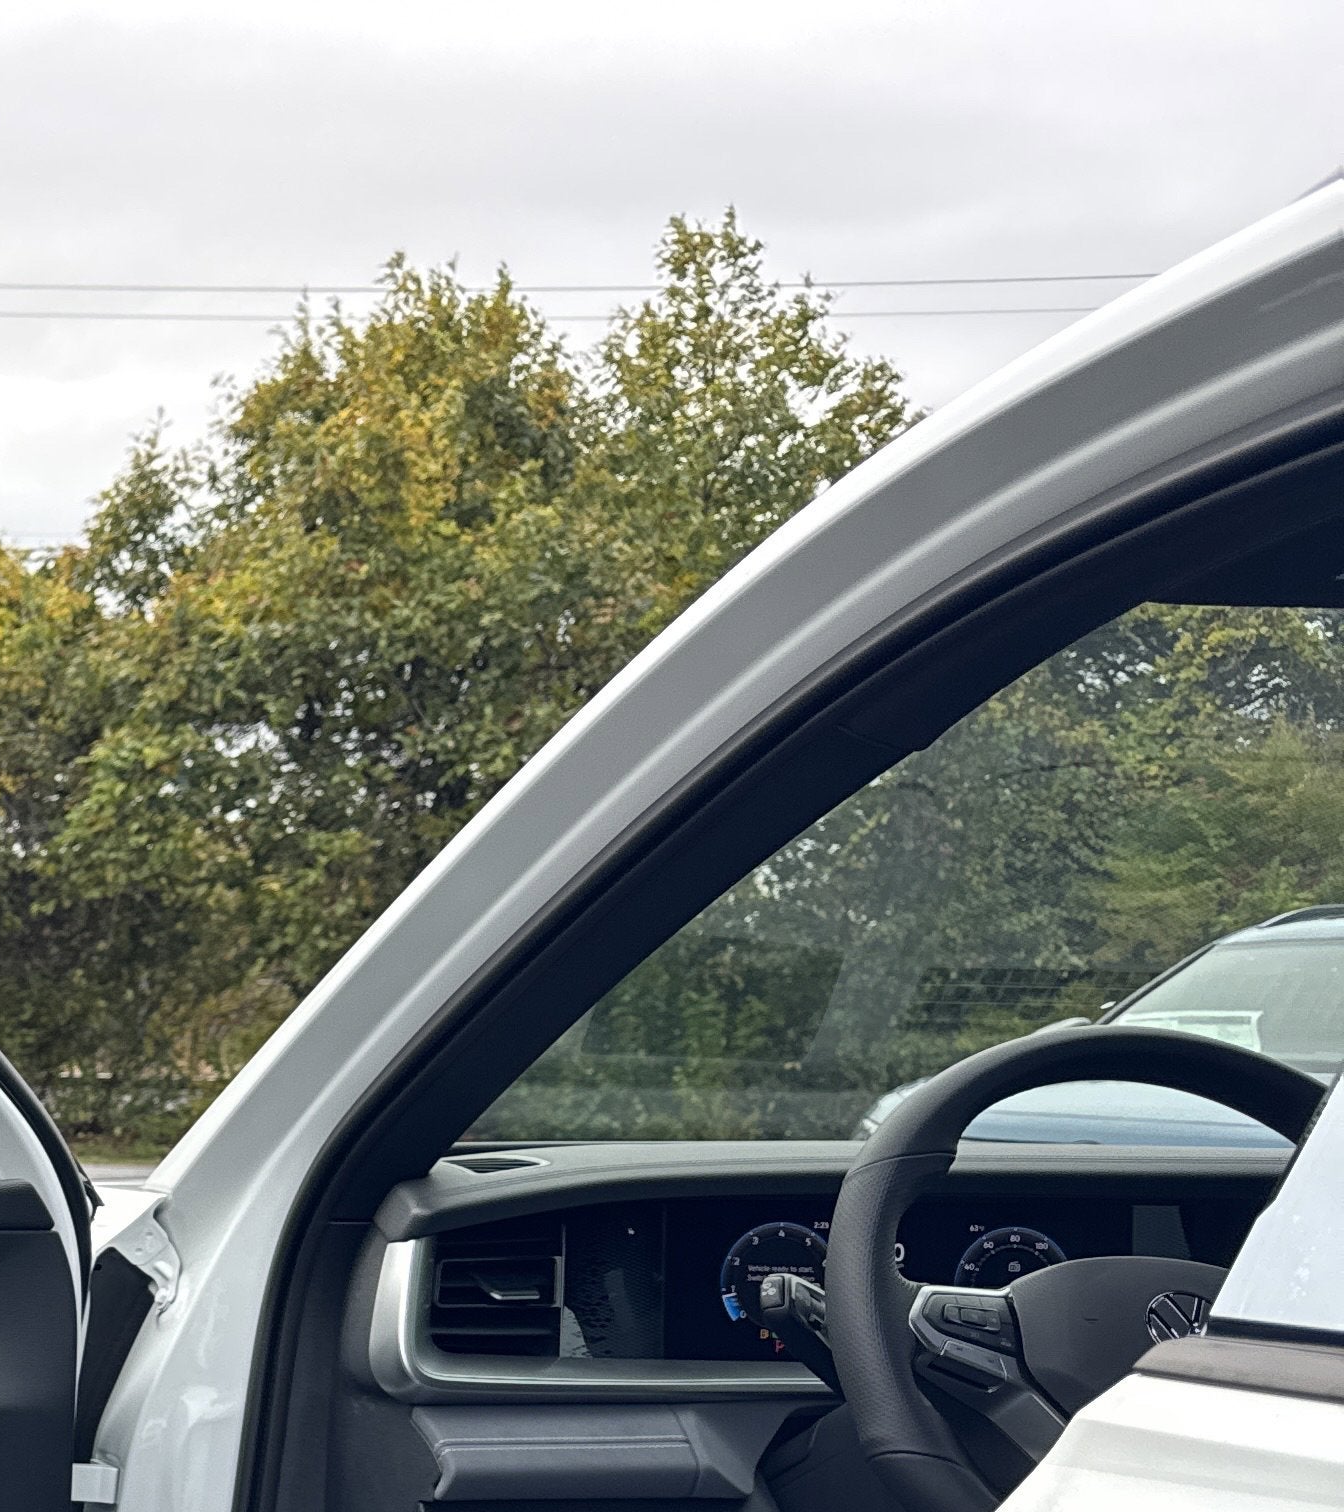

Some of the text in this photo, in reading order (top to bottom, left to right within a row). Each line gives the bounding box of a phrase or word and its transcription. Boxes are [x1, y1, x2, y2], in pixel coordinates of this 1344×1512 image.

[778, 1230, 785, 1238] 4
[752, 1237, 759, 1245] 3
[805, 1238, 811, 1246] 5
[1009, 1234, 1021, 1243] 80
[983, 1241, 994, 1249] 60
[1035, 1242, 1049, 1250] 100
[733, 1256, 740, 1266] 2
